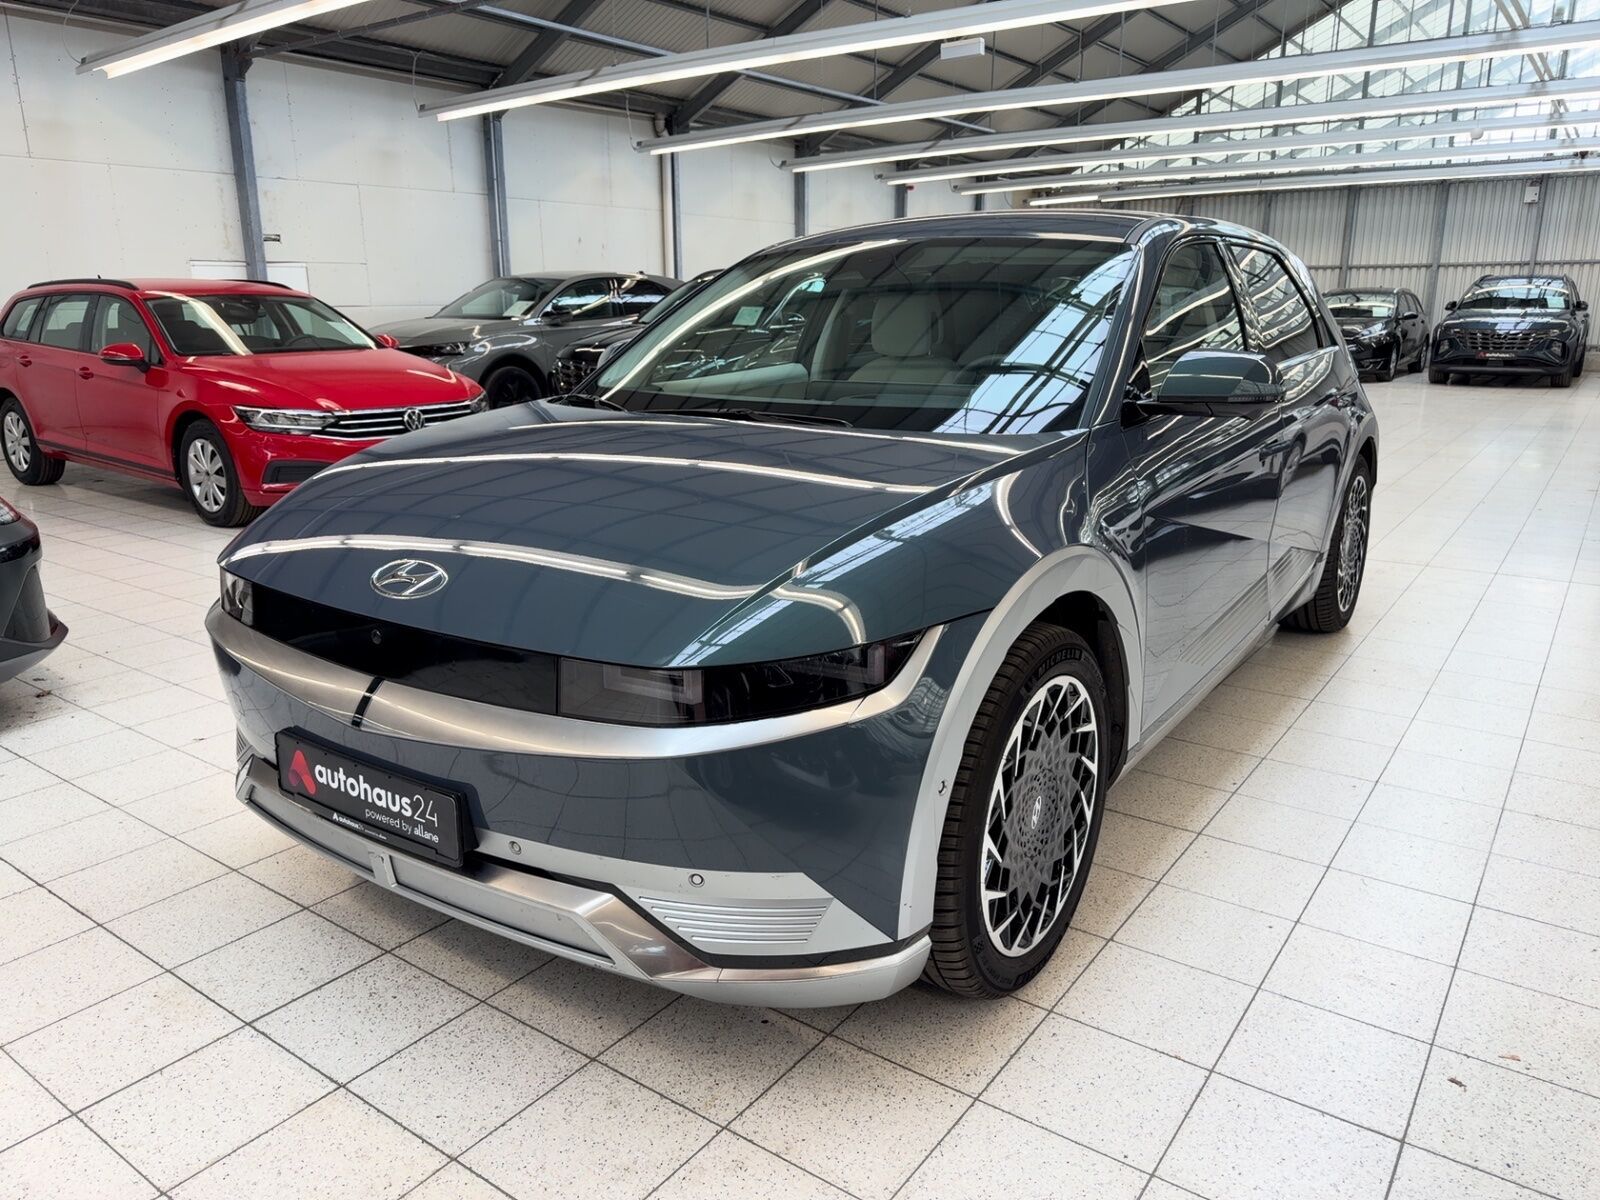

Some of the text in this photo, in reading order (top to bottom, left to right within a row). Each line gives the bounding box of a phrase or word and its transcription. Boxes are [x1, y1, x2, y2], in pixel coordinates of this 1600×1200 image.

[315, 764, 438, 827] autohaus24
[365, 809, 400, 827] powered
[402, 820, 412, 835] by
[414, 823, 439, 843] allane
